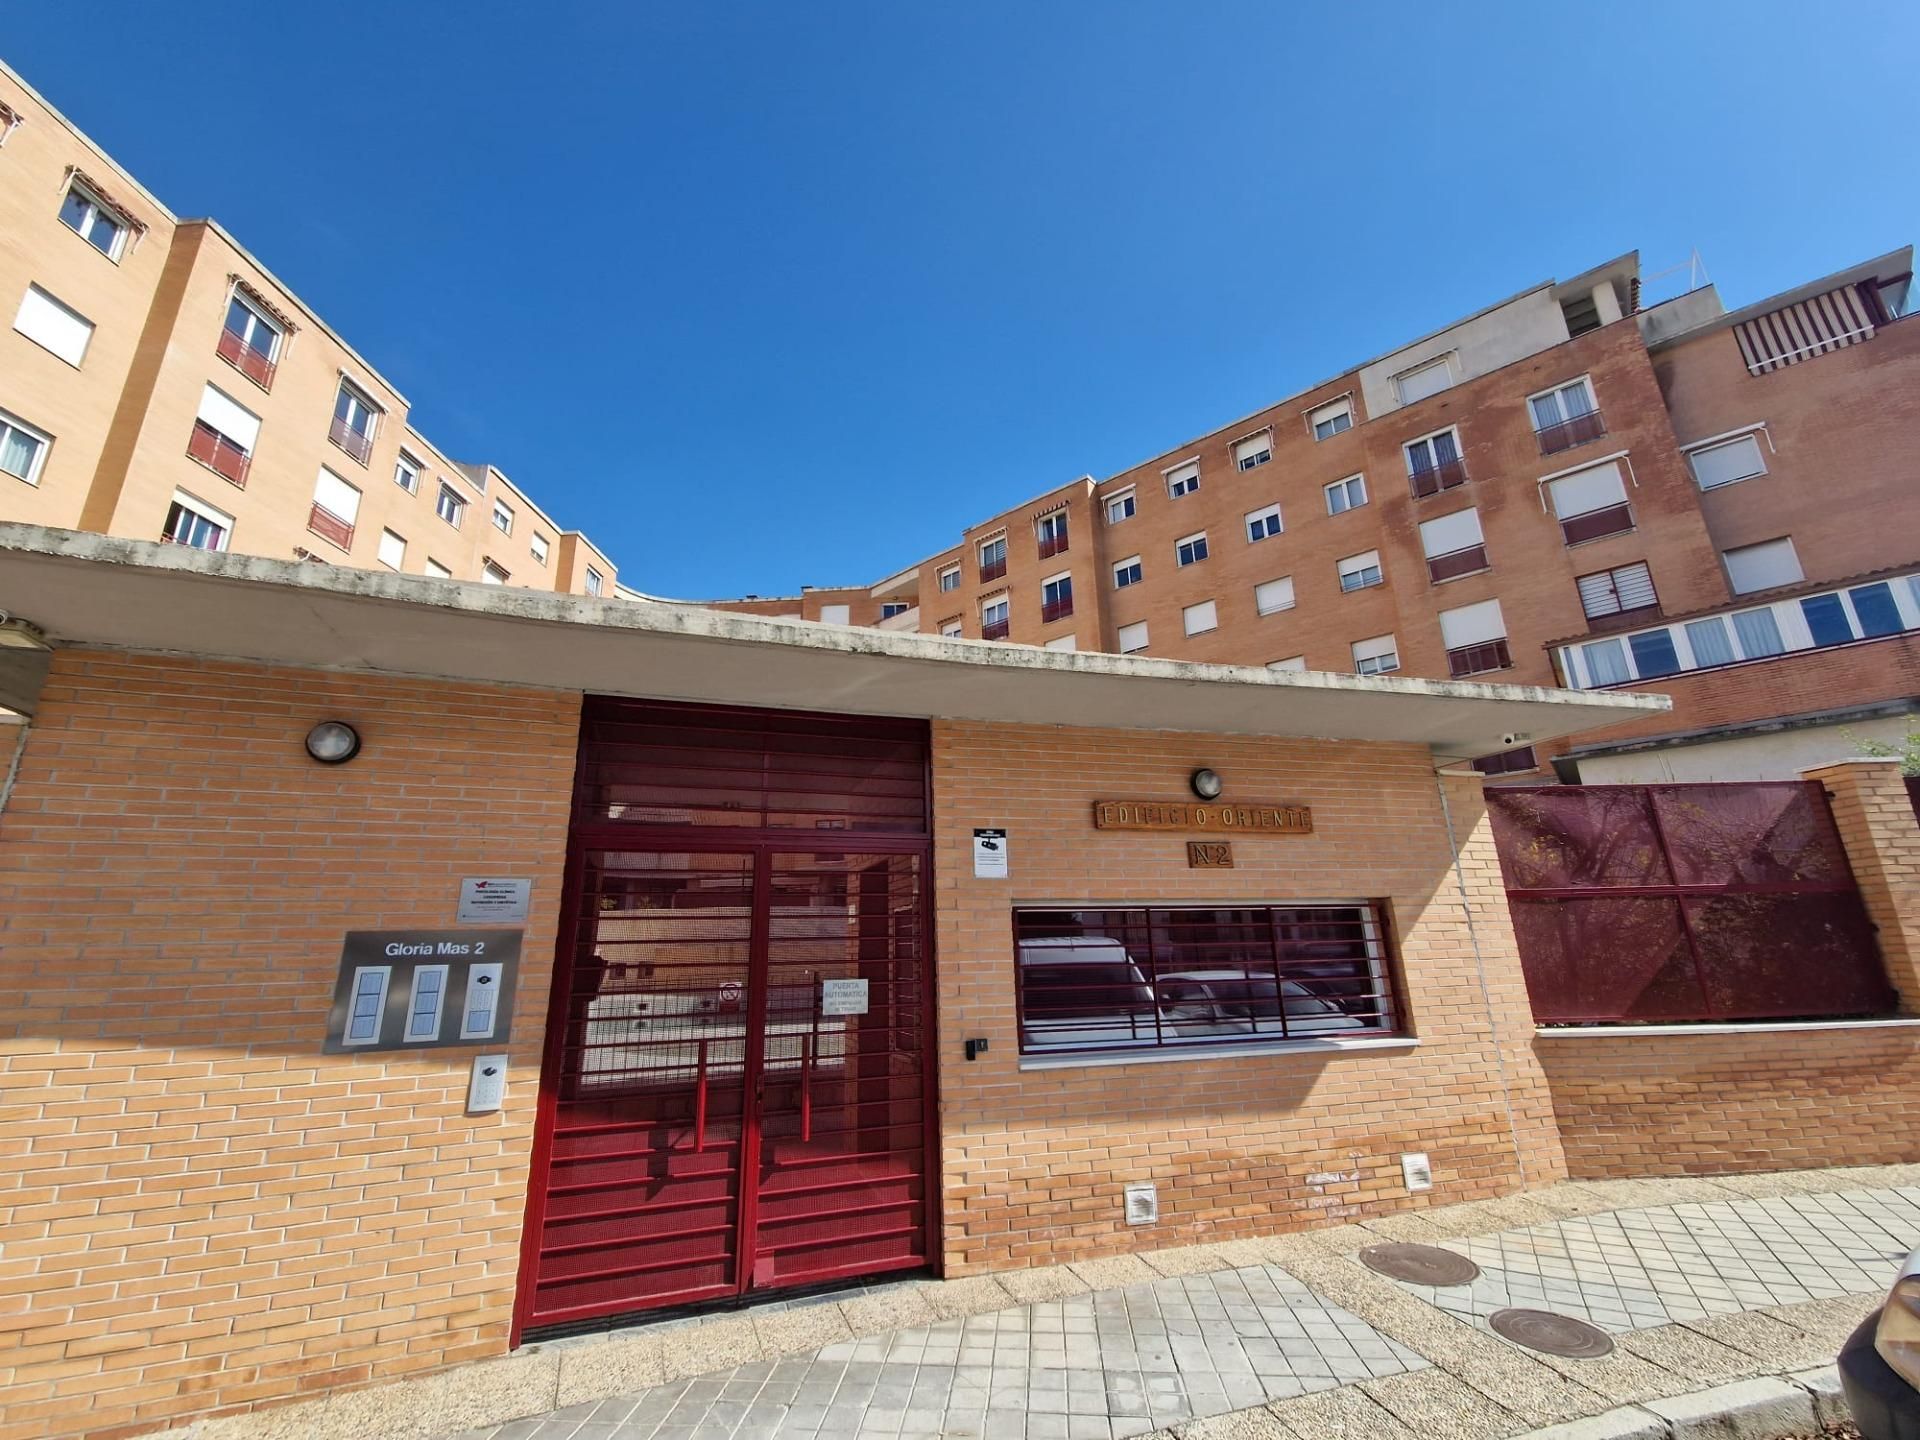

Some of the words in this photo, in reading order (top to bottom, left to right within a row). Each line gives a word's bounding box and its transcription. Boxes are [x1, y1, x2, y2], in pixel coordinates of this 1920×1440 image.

[1102, 805, 1207, 826] EDIFICIO
[1221, 807, 1312, 827] ORIENTE
[385, 942, 433, 956] Gloria
[437, 942, 469, 955] Mas
[474, 942, 485, 955] 2
[832, 982, 860, 990] PUERTA
